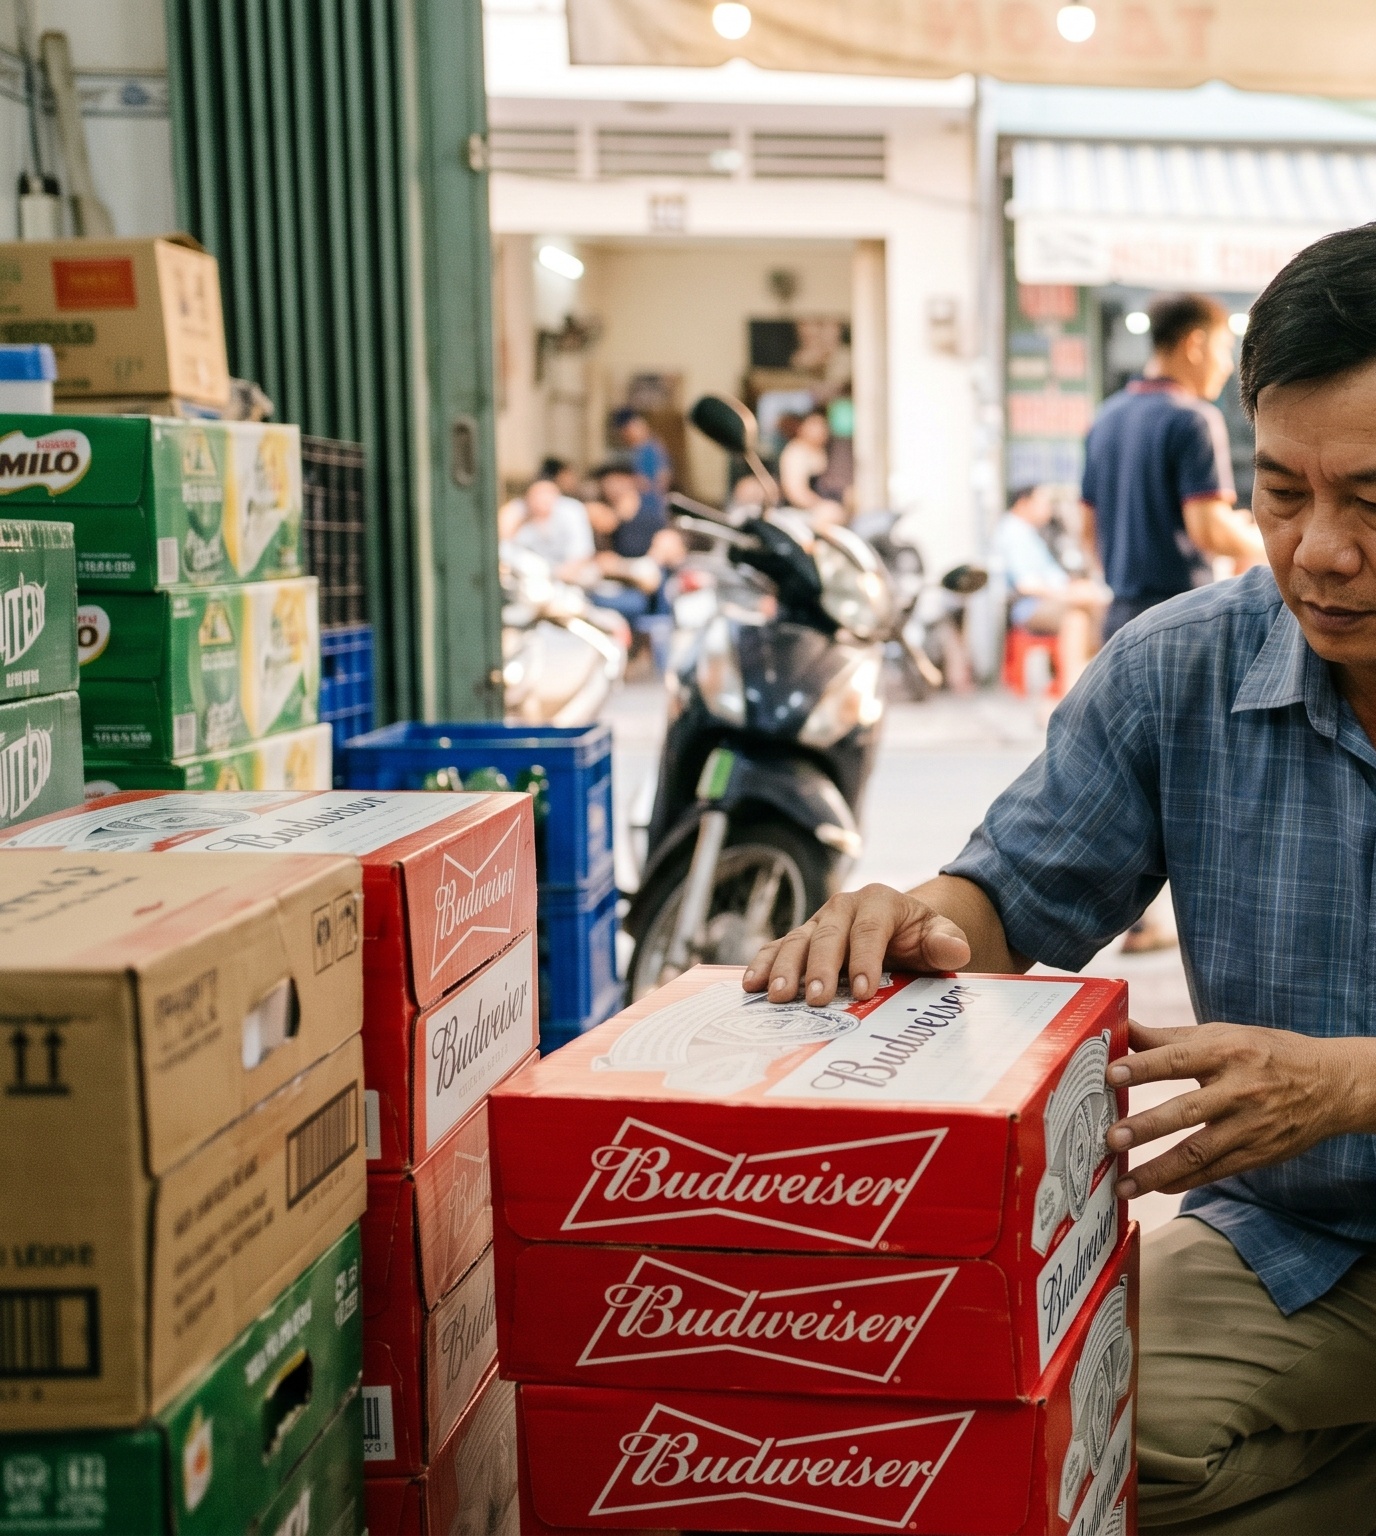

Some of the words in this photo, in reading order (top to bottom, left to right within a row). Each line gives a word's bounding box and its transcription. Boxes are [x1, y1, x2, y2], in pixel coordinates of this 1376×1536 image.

[0, 451, 80, 477] MILO
[435, 864, 514, 940] Budweiser
[432, 981, 528, 1098] Budweiser
[810, 984, 982, 1090] Budweiser
[591, 1146, 909, 1208] Budweiser
[1043, 1200, 1115, 1344] Budweiser
[604, 1285, 920, 1346] Budweiser
[619, 1431, 939, 1490] Budweiser
